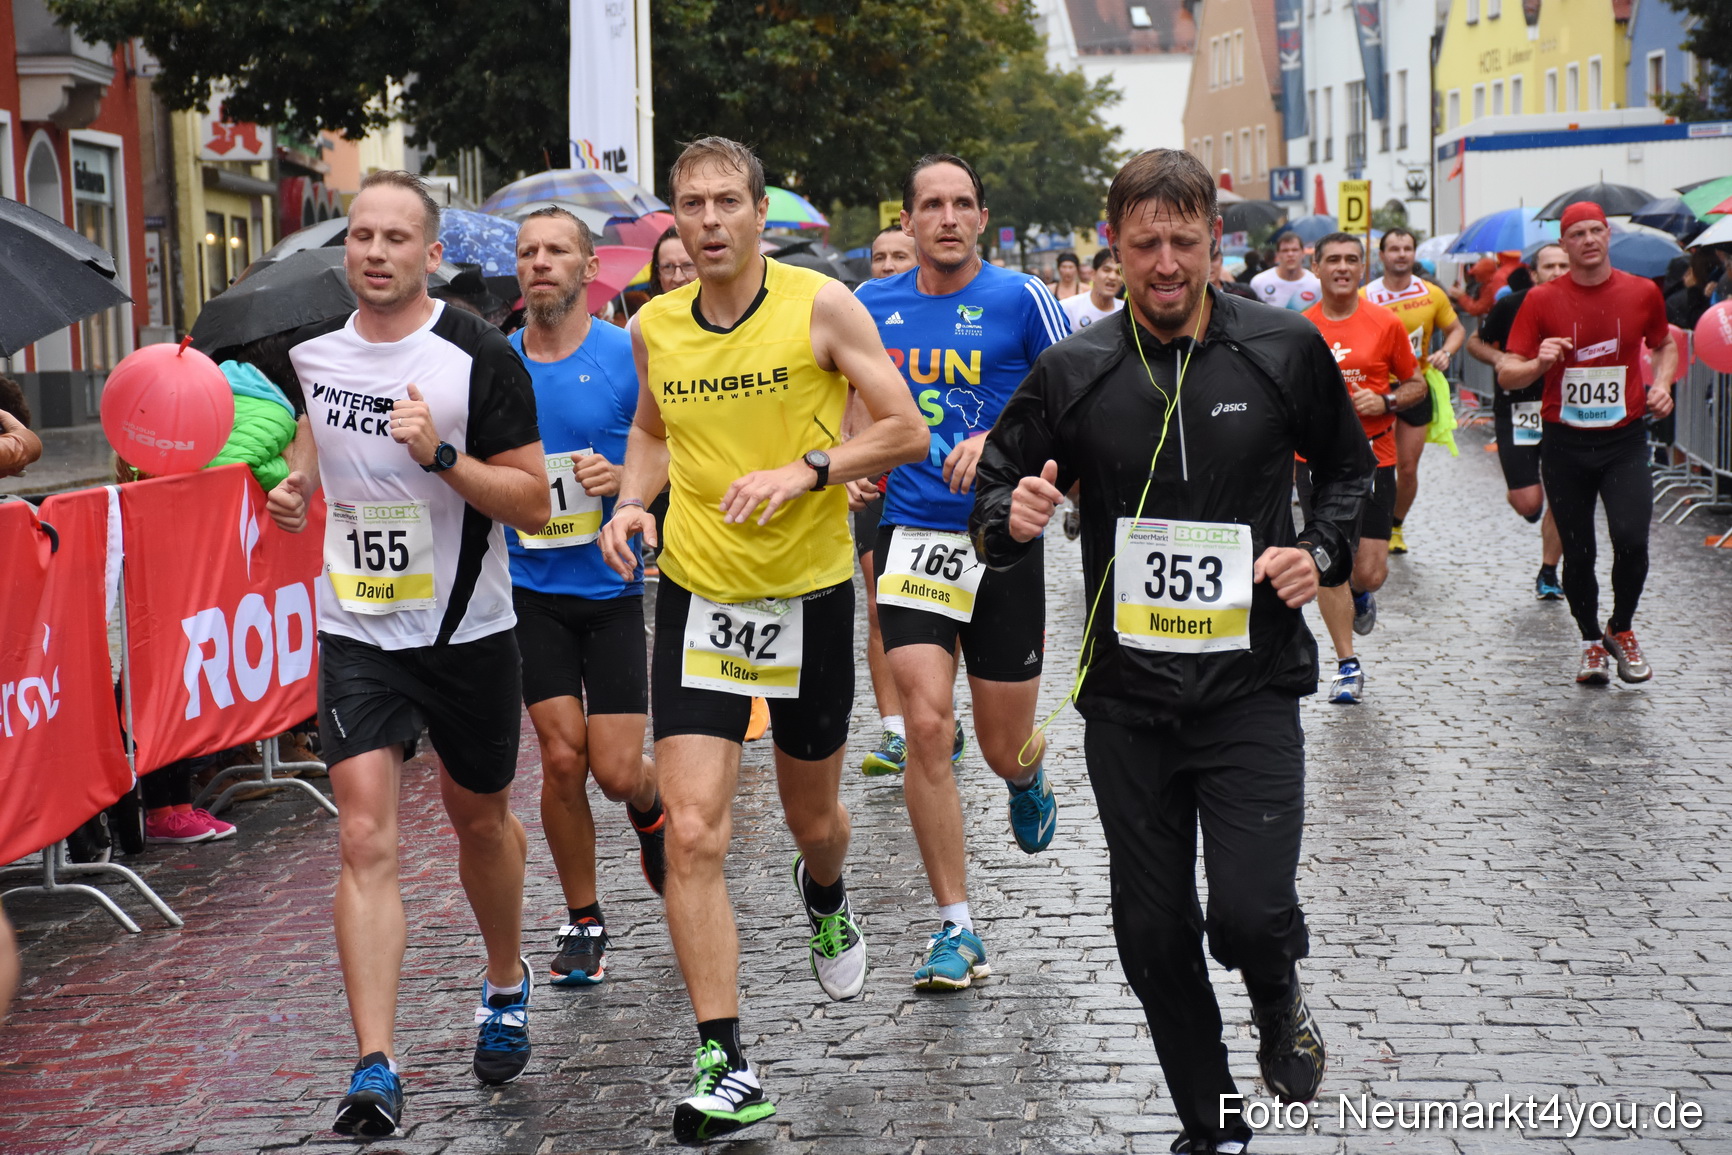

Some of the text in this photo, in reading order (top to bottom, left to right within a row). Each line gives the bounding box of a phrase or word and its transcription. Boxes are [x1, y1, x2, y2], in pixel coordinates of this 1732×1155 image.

[1479, 48, 1502, 73] HOTEL
[1343, 183, 1368, 192] Block
[1347, 197, 1363, 222] D
[664, 367, 788, 396] KLINGELE
[324, 387, 402, 414] INTERSP
[663, 384, 789, 404] PAPIERWERKE
[1567, 382, 1619, 404] 2043
[1578, 411, 1607, 420] Robert
[363, 506, 420, 519] BOCK
[1174, 526, 1240, 544] BOCK
[346, 529, 410, 571] 155
[910, 544, 968, 581] 165
[1145, 551, 1222, 603] 353
[356, 582, 394, 599] David
[901, 580, 951, 603] Andreas
[1150, 612, 1212, 634] Norbert
[709, 612, 782, 660] 342
[721, 660, 758, 681] Klaus
